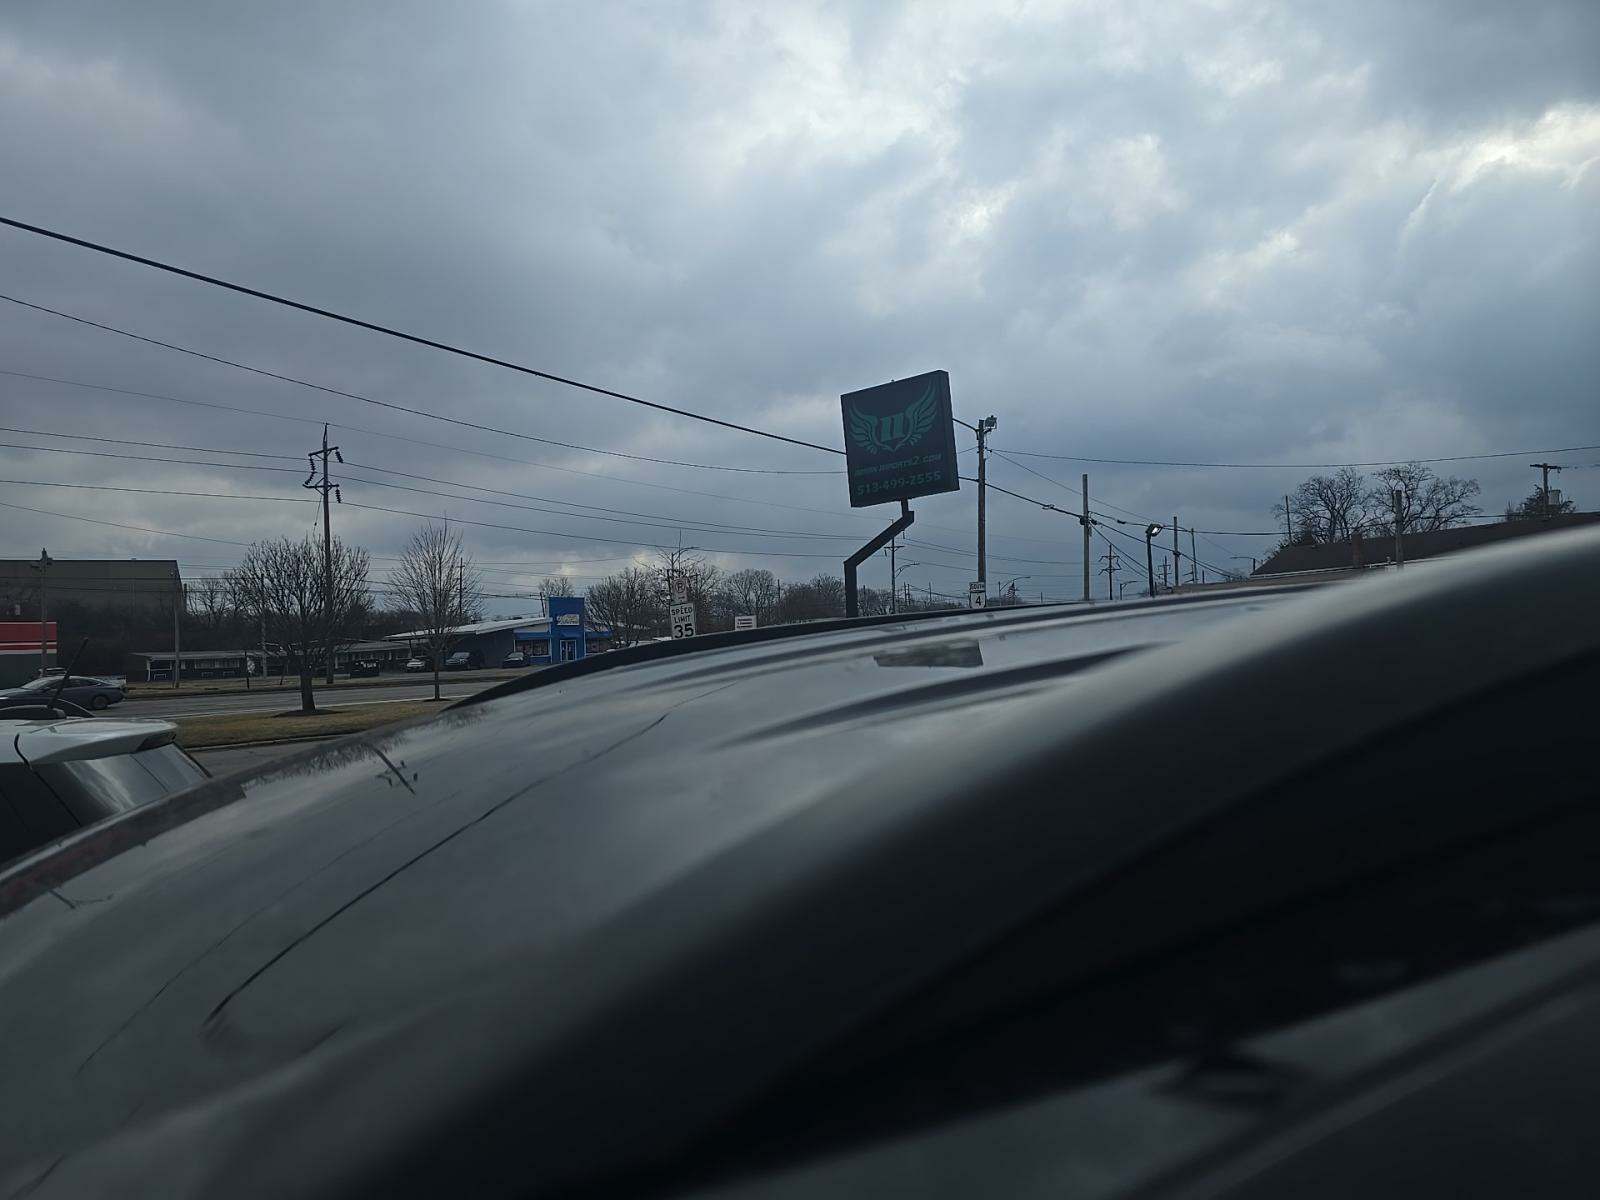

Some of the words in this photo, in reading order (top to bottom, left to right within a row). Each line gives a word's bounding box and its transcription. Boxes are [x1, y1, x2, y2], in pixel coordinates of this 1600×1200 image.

[975, 595, 982, 606] 4
[671, 607, 693, 616] SPEED
[674, 615, 691, 624] LIMIT
[674, 623, 694, 638] 35
